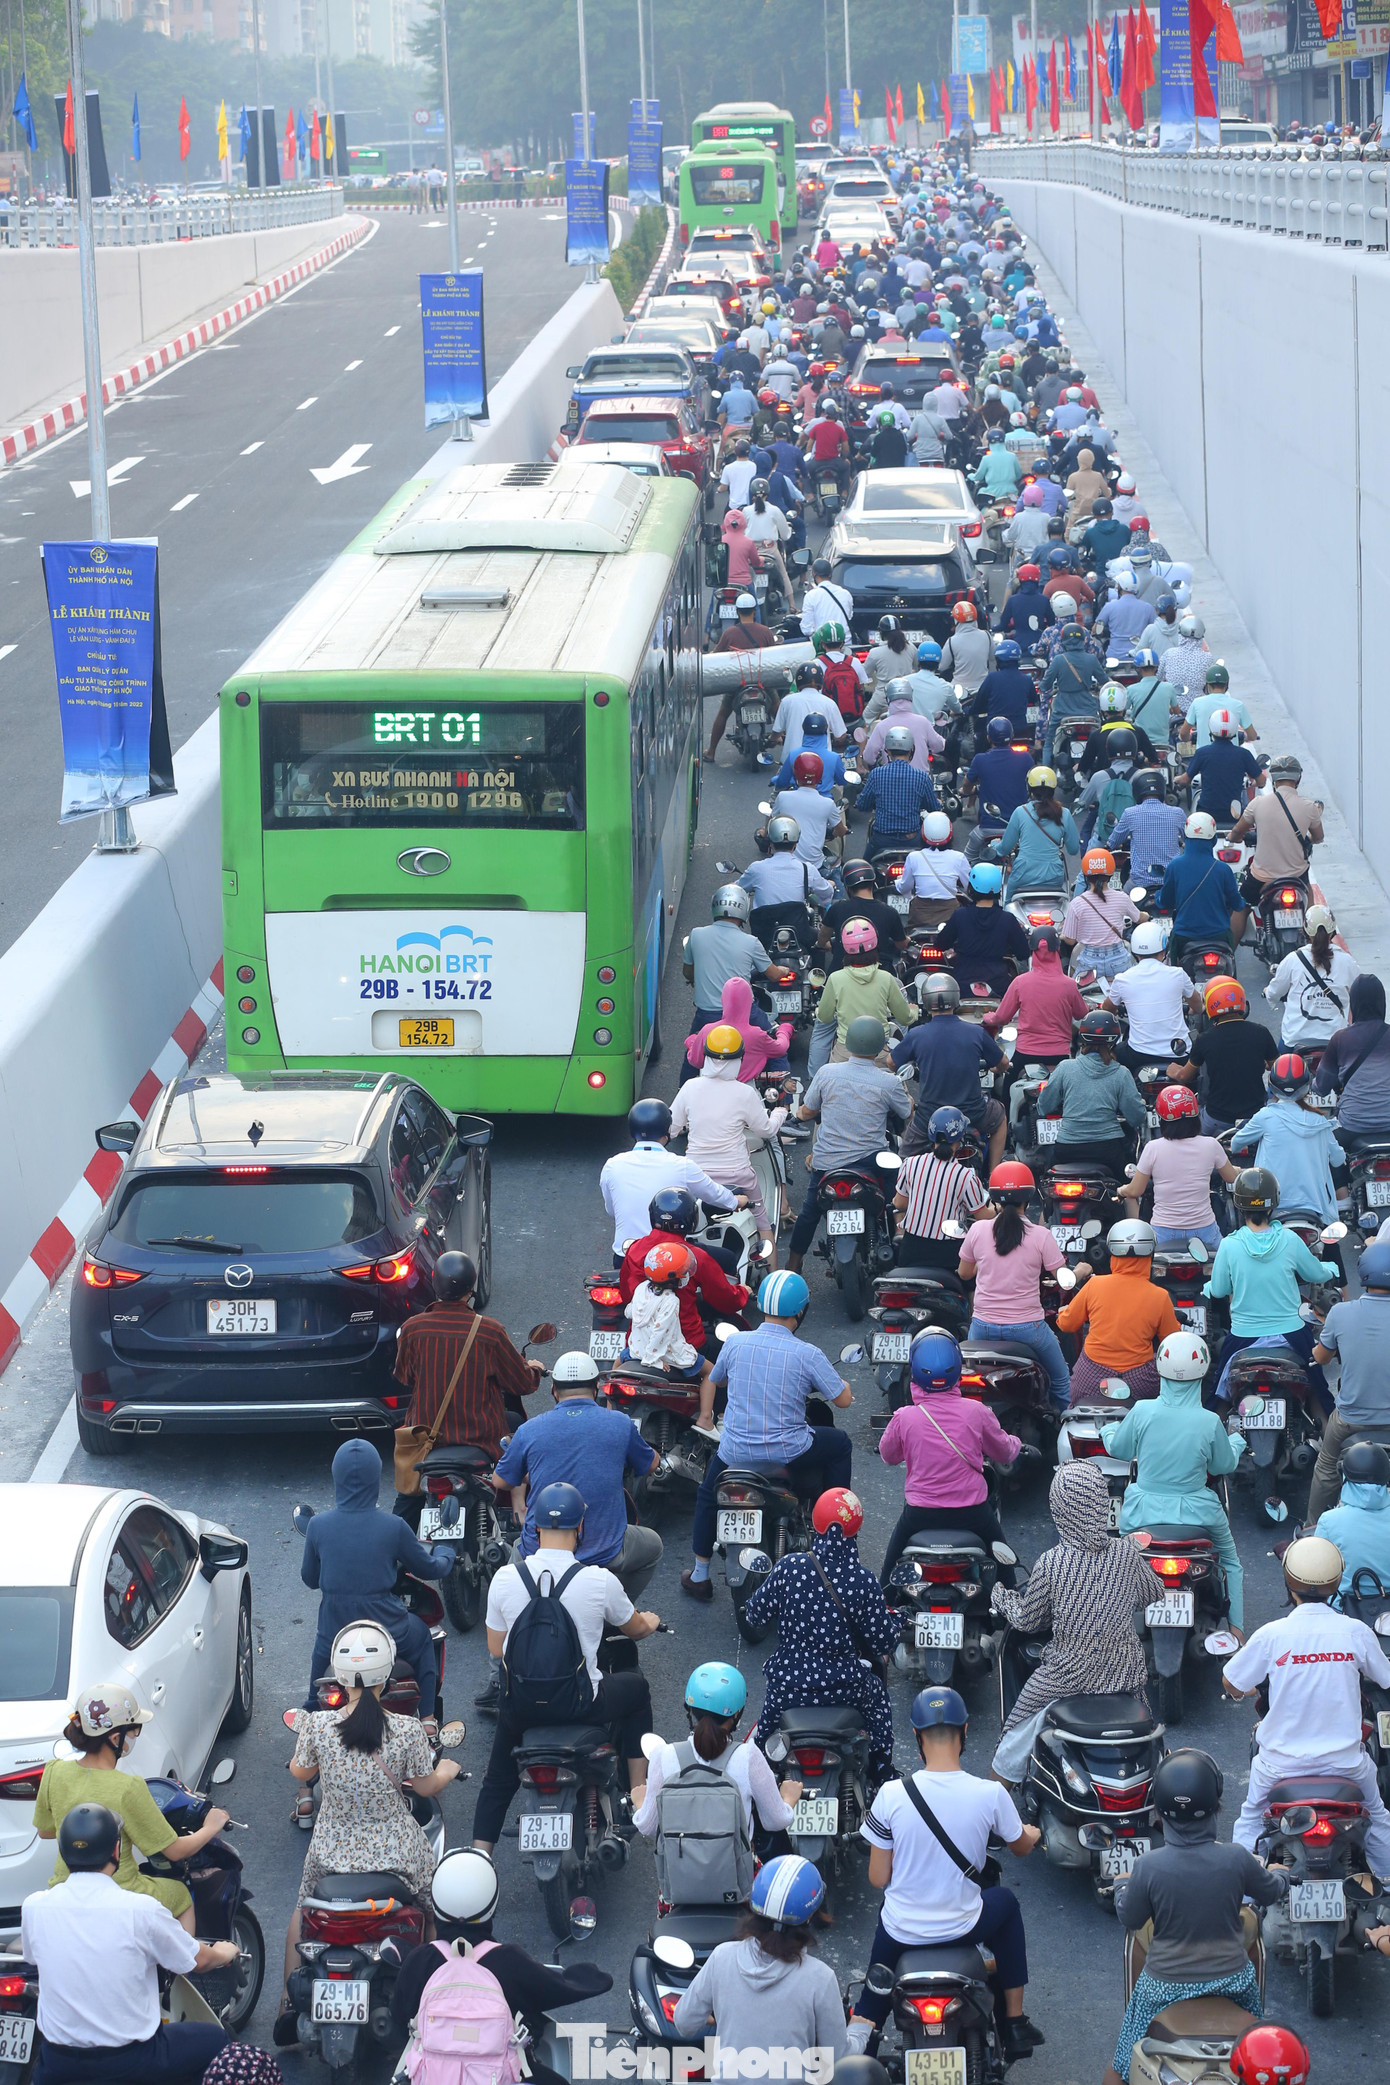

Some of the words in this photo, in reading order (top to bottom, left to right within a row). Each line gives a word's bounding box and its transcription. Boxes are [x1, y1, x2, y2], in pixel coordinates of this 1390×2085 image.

[1301, 39, 1327, 47] CENTER
[1359, 27, 1389, 44] 118
[432, 309, 455, 317] KHÁNH
[456, 309, 480, 317] THÀNH
[68, 565, 78, 574] ỦY
[95, 565, 115, 574] NHÂN
[116, 566, 132, 576] DÂN
[68, 575, 93, 584] THÀNH
[108, 576, 118, 584] HÀ
[120, 577, 133, 586] NỘI
[53, 604, 68, 619] LỄ
[70, 605, 106, 619] KHÁNH
[108, 606, 150, 621] THÀNH
[125, 678, 147, 687] TRÌNH
[120, 686, 132, 695] NỘI
[374, 712, 436, 742] BRT
[441, 712, 481, 742] 01
[360, 771, 390, 787] BUS
[394, 771, 452, 787] NHANH
[456, 768, 479, 787] HÀ
[483, 768, 515, 792] NỘI
[342, 794, 399, 809] Hotline
[404, 792, 459, 808] 1900
[468, 792, 522, 808] 1296
[360, 954, 441, 973] HANOI
[446, 954, 493, 973] BRT
[360, 979, 399, 999] 29B
[422, 979, 492, 1000] 154.72
[415, 1021, 438, 1032] 29B
[407, 1033, 449, 1045] 154.72
[1042, 1120, 1062, 1132] 18-B
[833, 1211, 859, 1222] 29-L1
[830, 1222, 862, 1234] 623.64
[227, 1301, 257, 1316] 30H
[113, 1314, 139, 1322] CX-5
[216, 1317, 268, 1332] 451.73
[594, 1333, 621, 1346] 29-E2
[880, 1335, 906, 1348] 29-D1
[875, 1348, 909, 1360] 241.65
[724, 1512, 756, 1526] 29-U6
[923, 1616, 957, 1631] 35-N1
[1149, 1609, 1190, 1625] 778.71
[919, 1631, 961, 1647] 065.69
[1292, 1652, 1355, 1665] HONDA
[528, 1816, 564, 1832] 29-T1
[523, 1832, 569, 1849] 384.88
[1298, 1882, 1337, 1901] 29-X7
[1294, 1902, 1342, 1919] 041.50
[320, 1983, 361, 2001] 29-M1
[315, 2002, 366, 2021] 065.76
[915, 2050, 956, 2070] 43-D1
